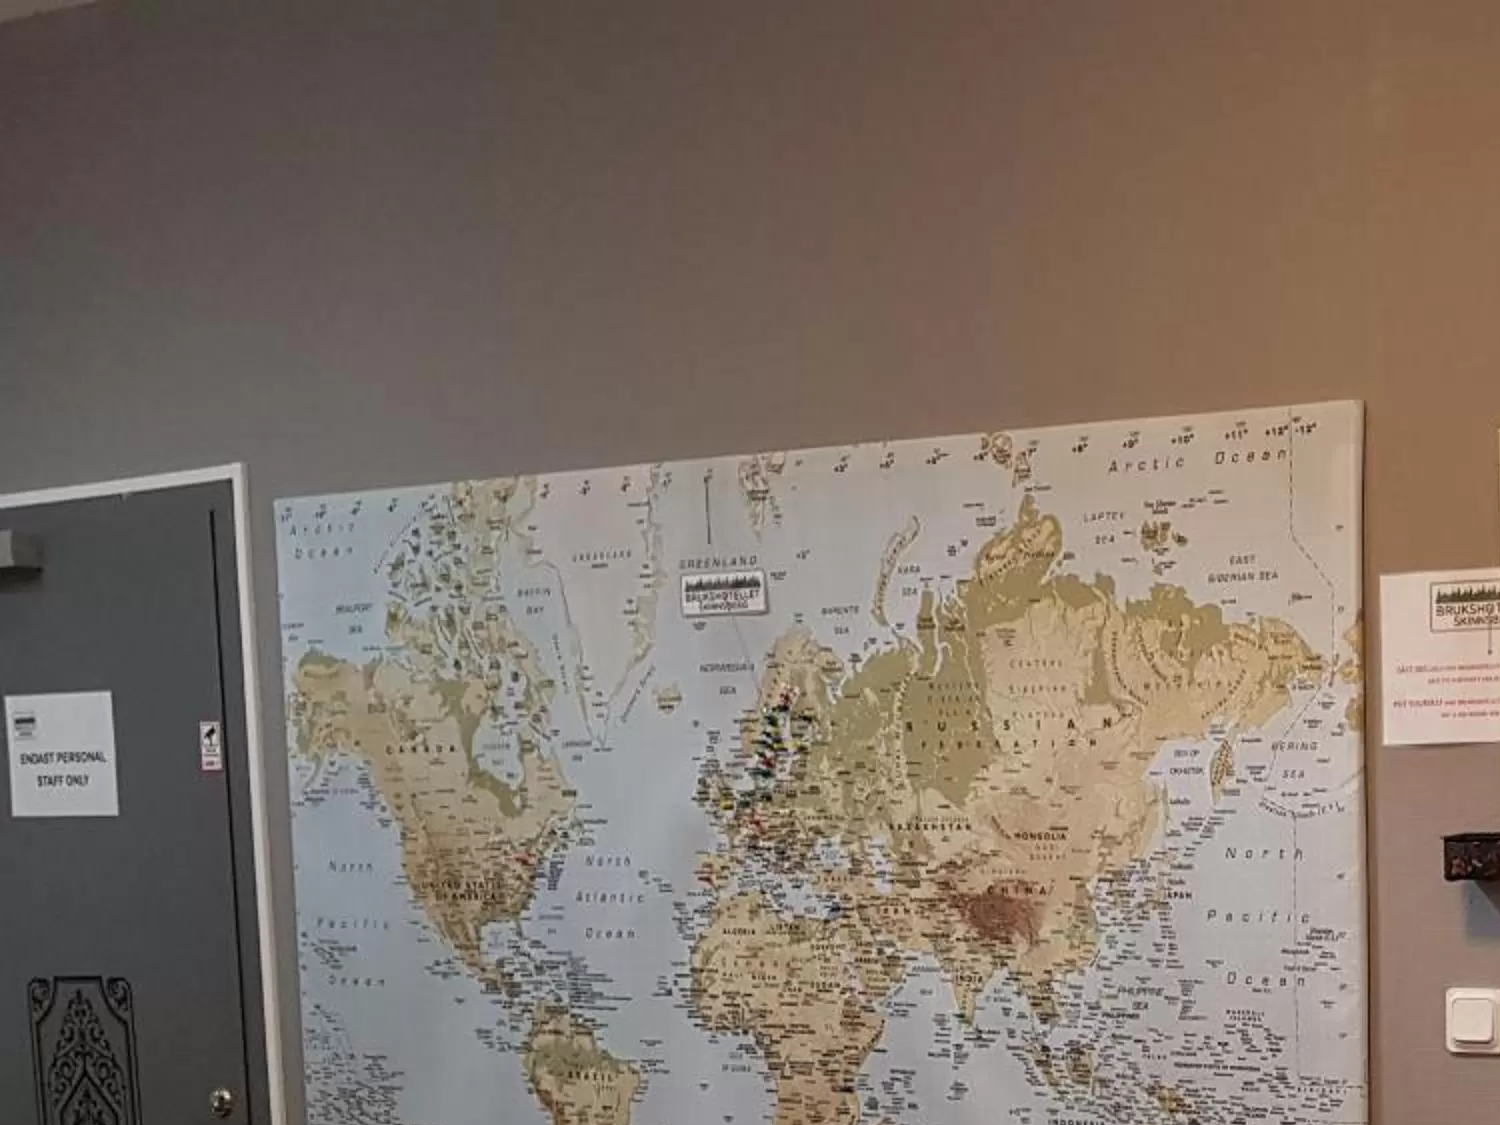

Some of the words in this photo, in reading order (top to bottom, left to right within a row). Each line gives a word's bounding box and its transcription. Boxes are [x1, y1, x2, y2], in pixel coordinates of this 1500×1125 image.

[1108, 455, 1186, 474] Arctic
[1215, 449, 1288, 466] Ocean
[20, 753, 54, 765] ENDAST
[56, 751, 106, 763] PERSONAL
[37, 775, 64, 788] STAFF
[65, 774, 89, 786] ONLY
[1225, 847, 1304, 860] North
[1207, 909, 1310, 923] Pacific
[1227, 971, 1305, 986] Ocean
